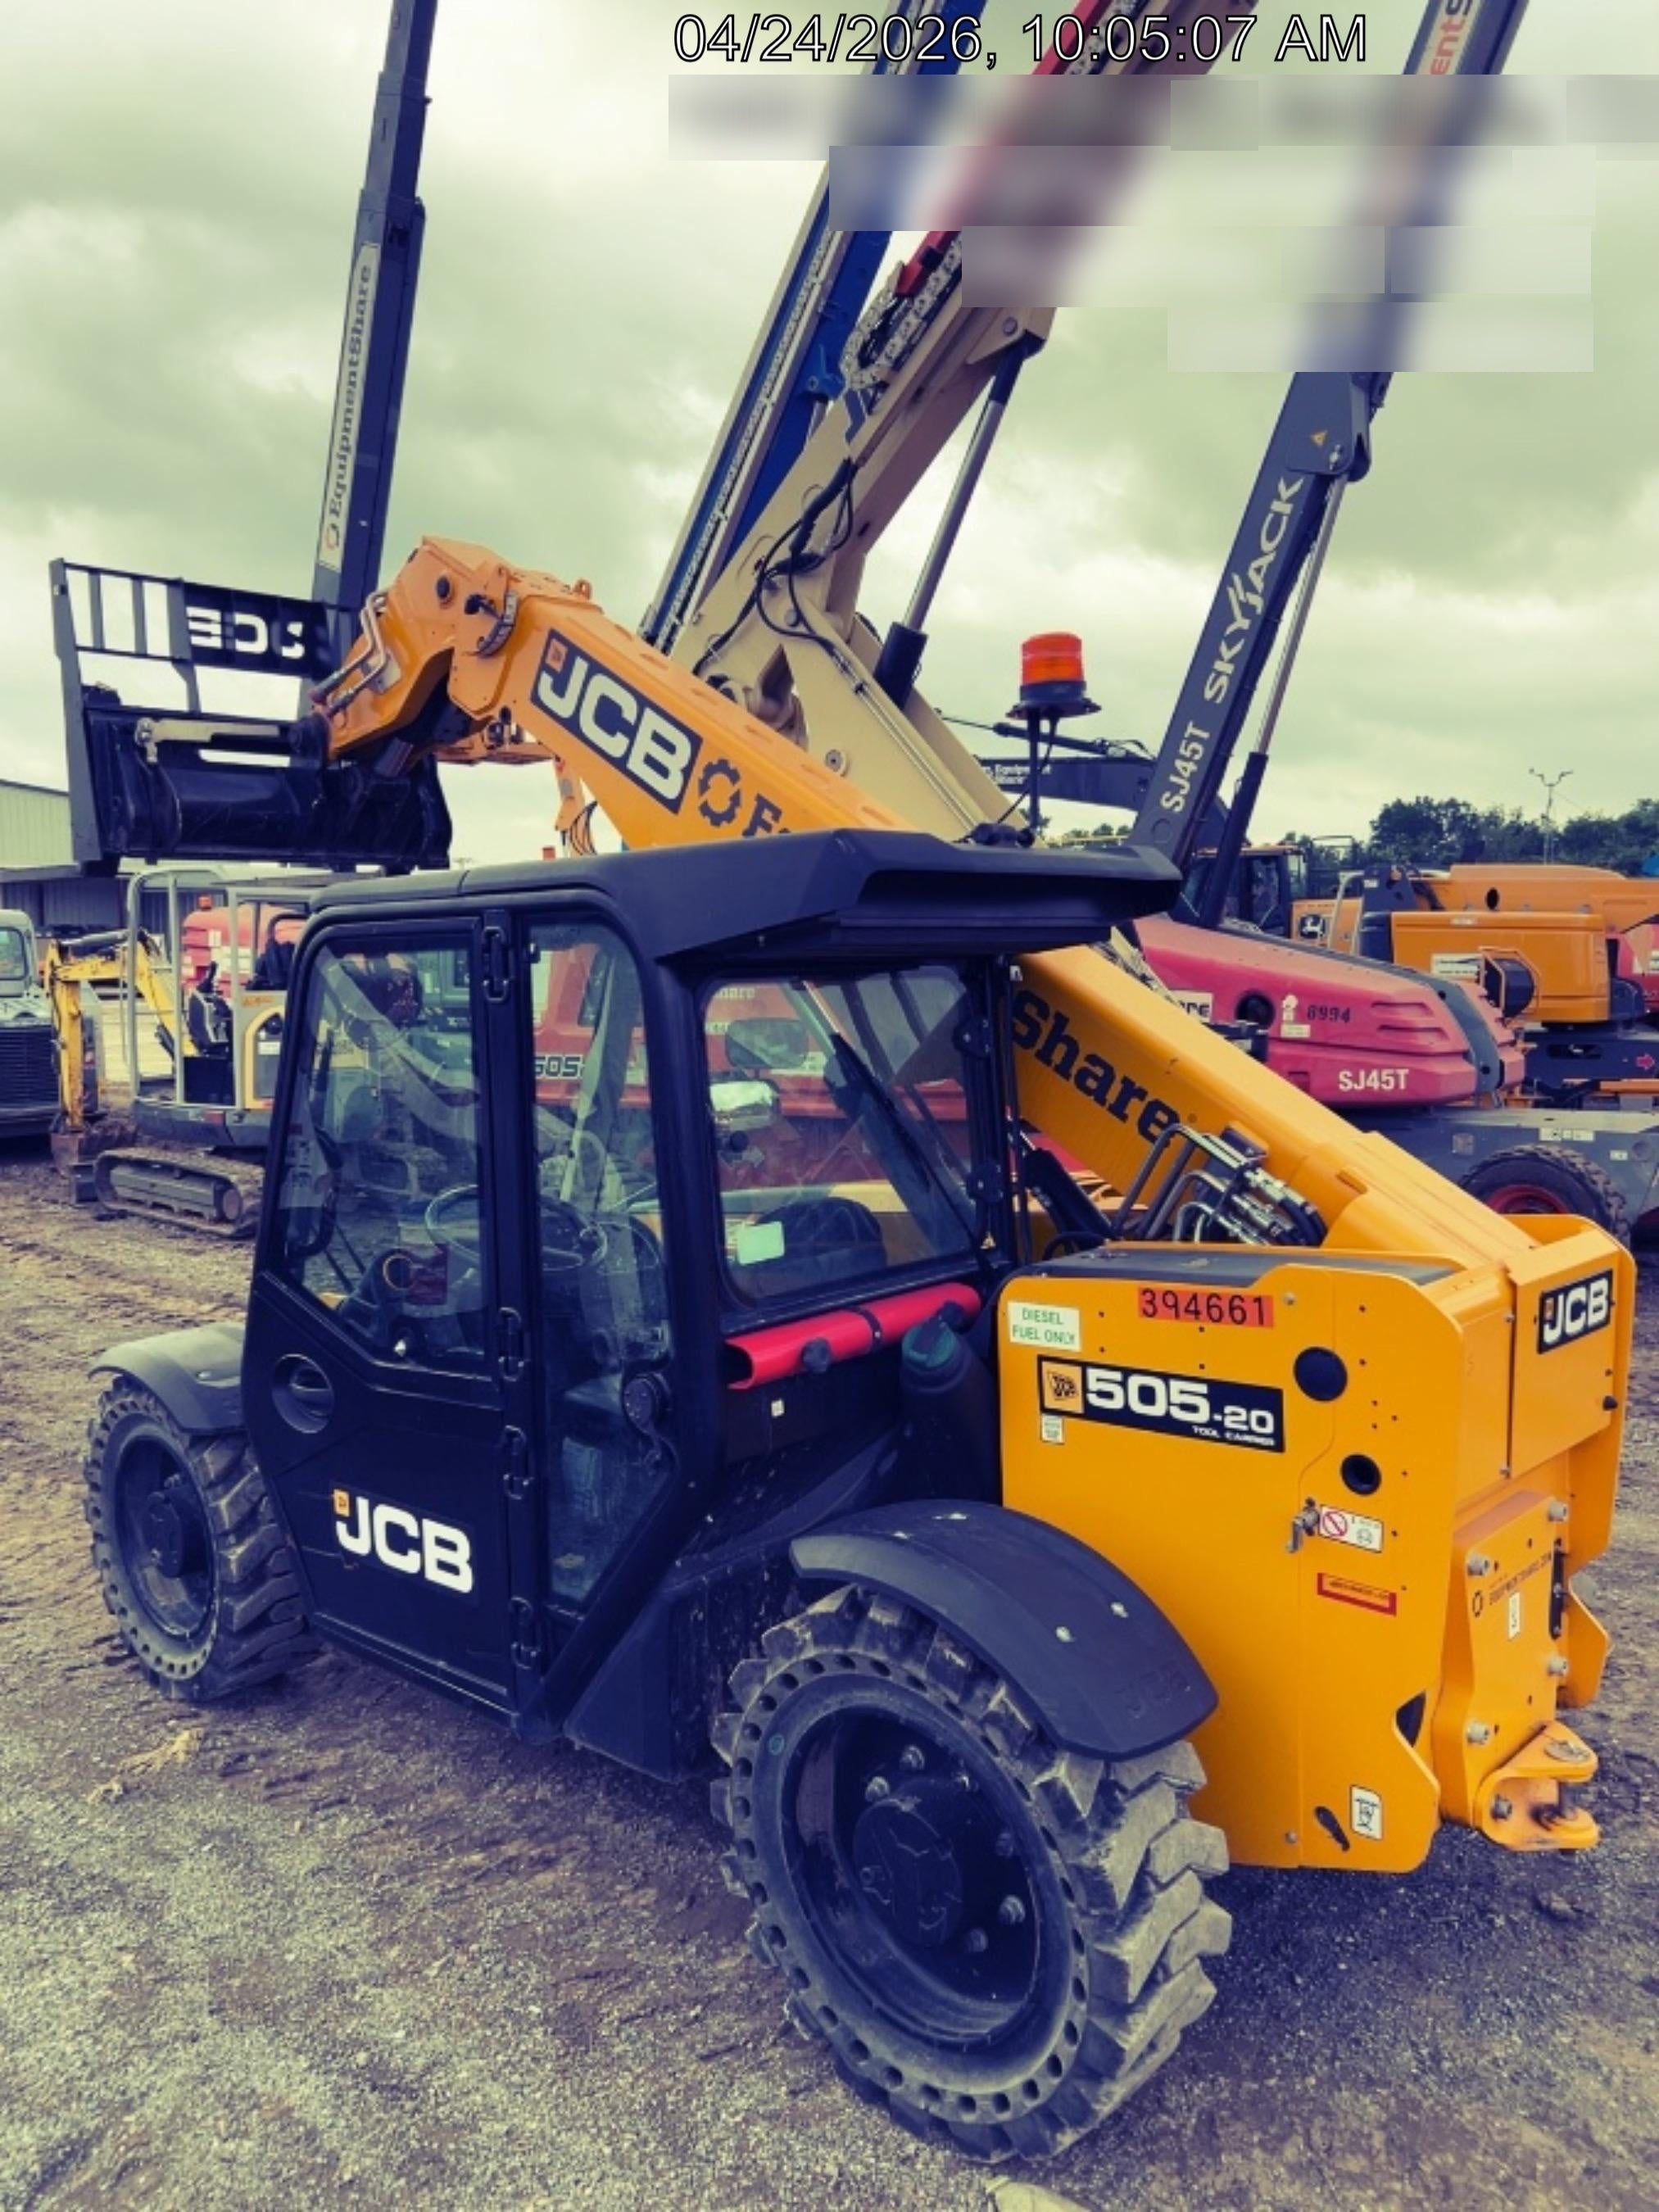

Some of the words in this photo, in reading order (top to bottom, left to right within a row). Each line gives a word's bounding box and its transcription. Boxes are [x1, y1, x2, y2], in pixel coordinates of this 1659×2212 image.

[329, 265, 372, 518] EquipmentShare
[1203, 476, 1304, 704] SKYJACK
[537, 655, 692, 800] JCB
[1160, 720, 1210, 813] SJ45T
[1012, 989, 1181, 1146] Share
[1339, 1068, 1409, 1091] SJ45T
[1013, 1325, 1040, 1341] FUEL
[1045, 1329, 1076, 1346] ONLY
[1022, 1307, 1063, 1326] DIESEL
[1140, 1288, 1267, 1326] 394661
[1543, 1277, 1609, 1344] JCB
[336, 1496, 474, 1594] JCB
